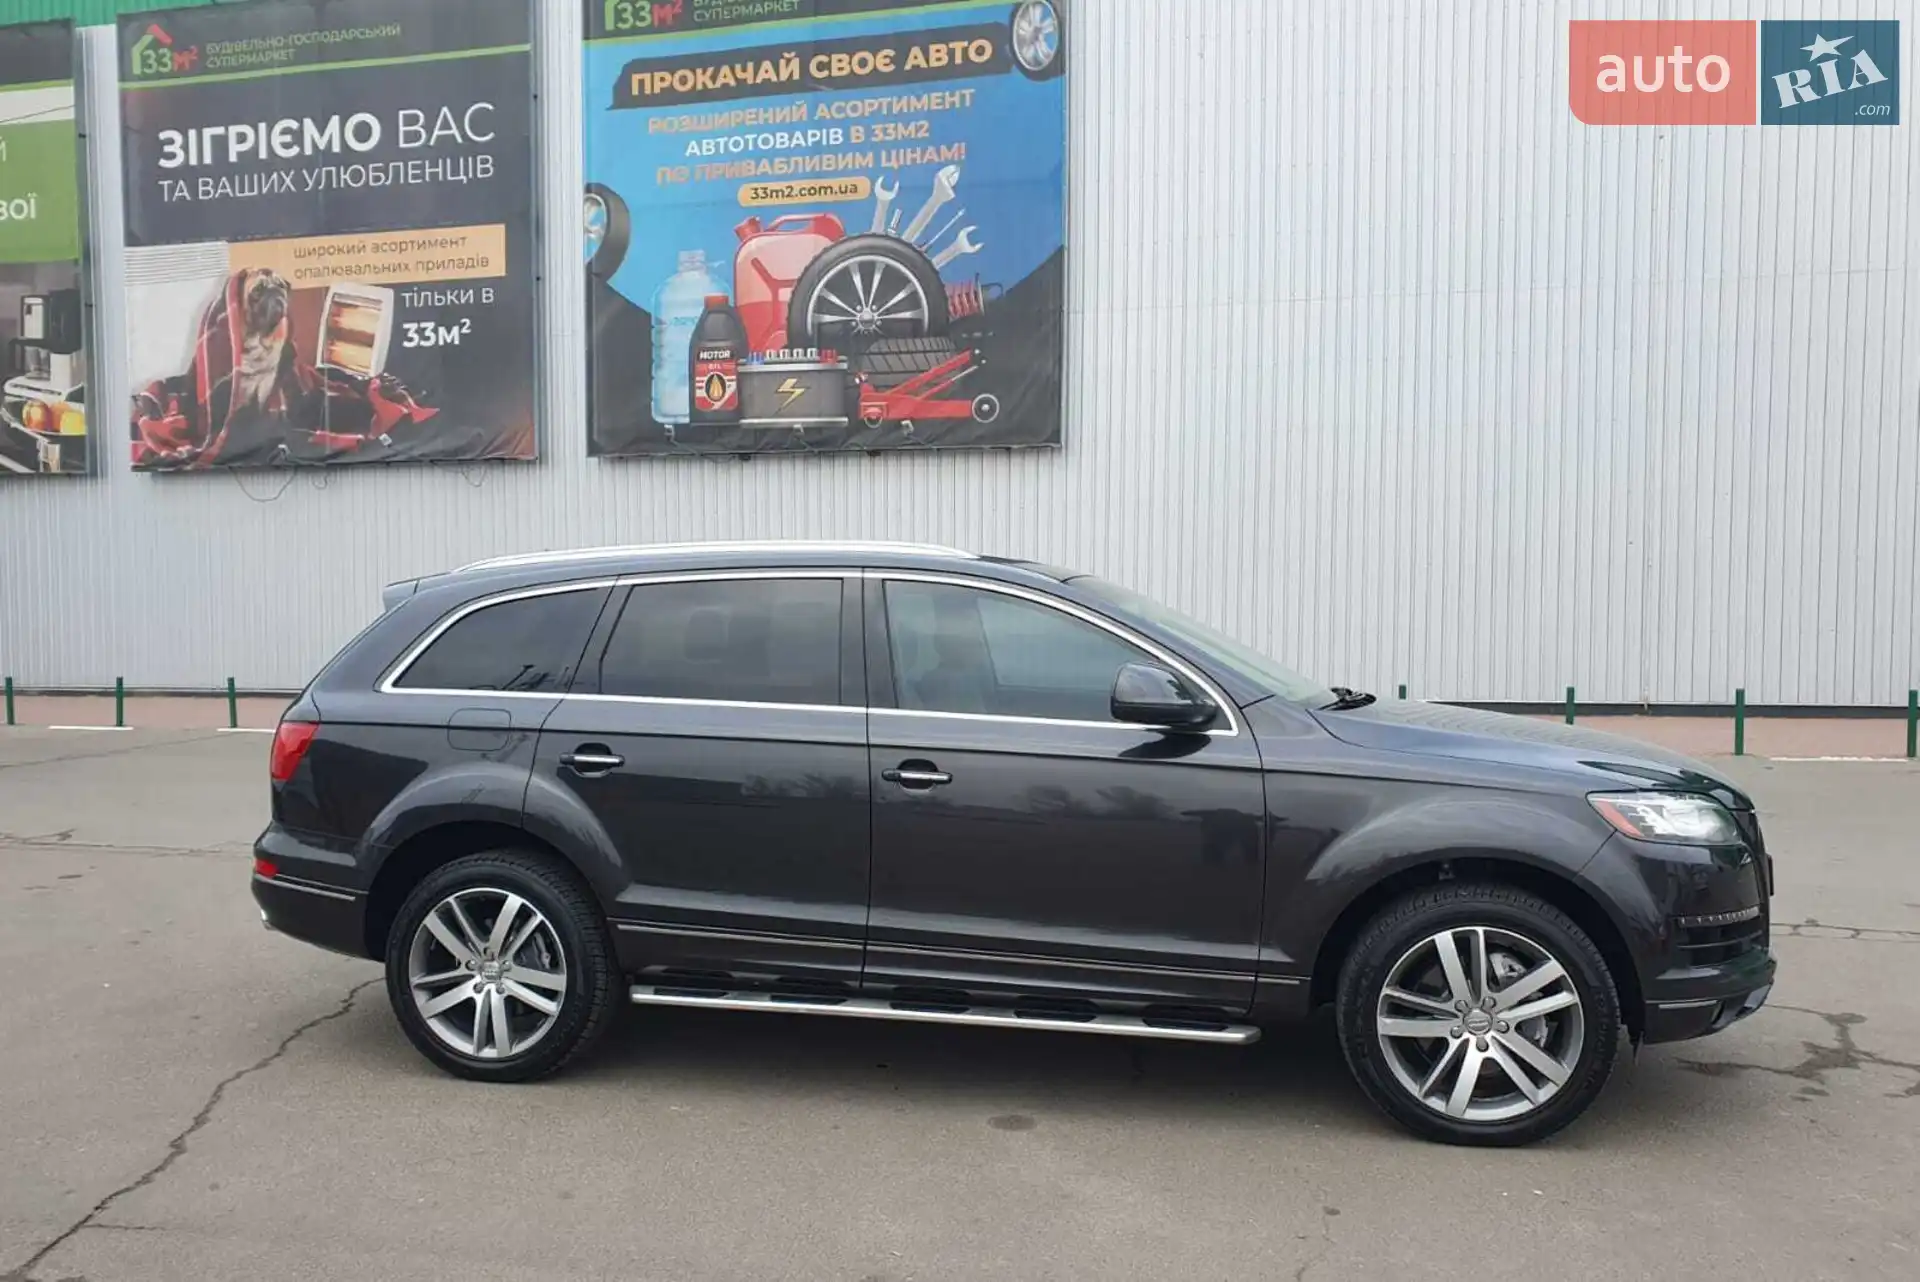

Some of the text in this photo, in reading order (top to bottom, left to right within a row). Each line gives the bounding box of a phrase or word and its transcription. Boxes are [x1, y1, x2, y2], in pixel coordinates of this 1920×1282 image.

[693, 0, 800, 23] СУПЕРМАРКЕТ
[205, 48, 296, 68] СУПЕРМАРКЕТ
[630, 38, 994, 96] ПРОКАЧАЙ СВОЄ АВТО
[648, 88, 976, 135] РОЗШИРЕНИЙ АСОРТИМЕНТ
[158, 102, 496, 169] ЗІГРІЄМО ВАС
[685, 120, 930, 157] АВТОТОВАРІВ В 33М2
[656, 142, 967, 186] ПО ПРИВАБЛИВИМ ЦІНАМ!
[158, 155, 495, 203] ТА ВАШИХ УЛЮБЛЕНЦІВ
[750, 182, 859, 202] 33m2.com.ua
[293, 236, 468, 260] широкий асортимент
[294, 254, 490, 280] опалювальних приладів
[401, 287, 474, 309] тільки
[699, 350, 731, 360] MOTOR
